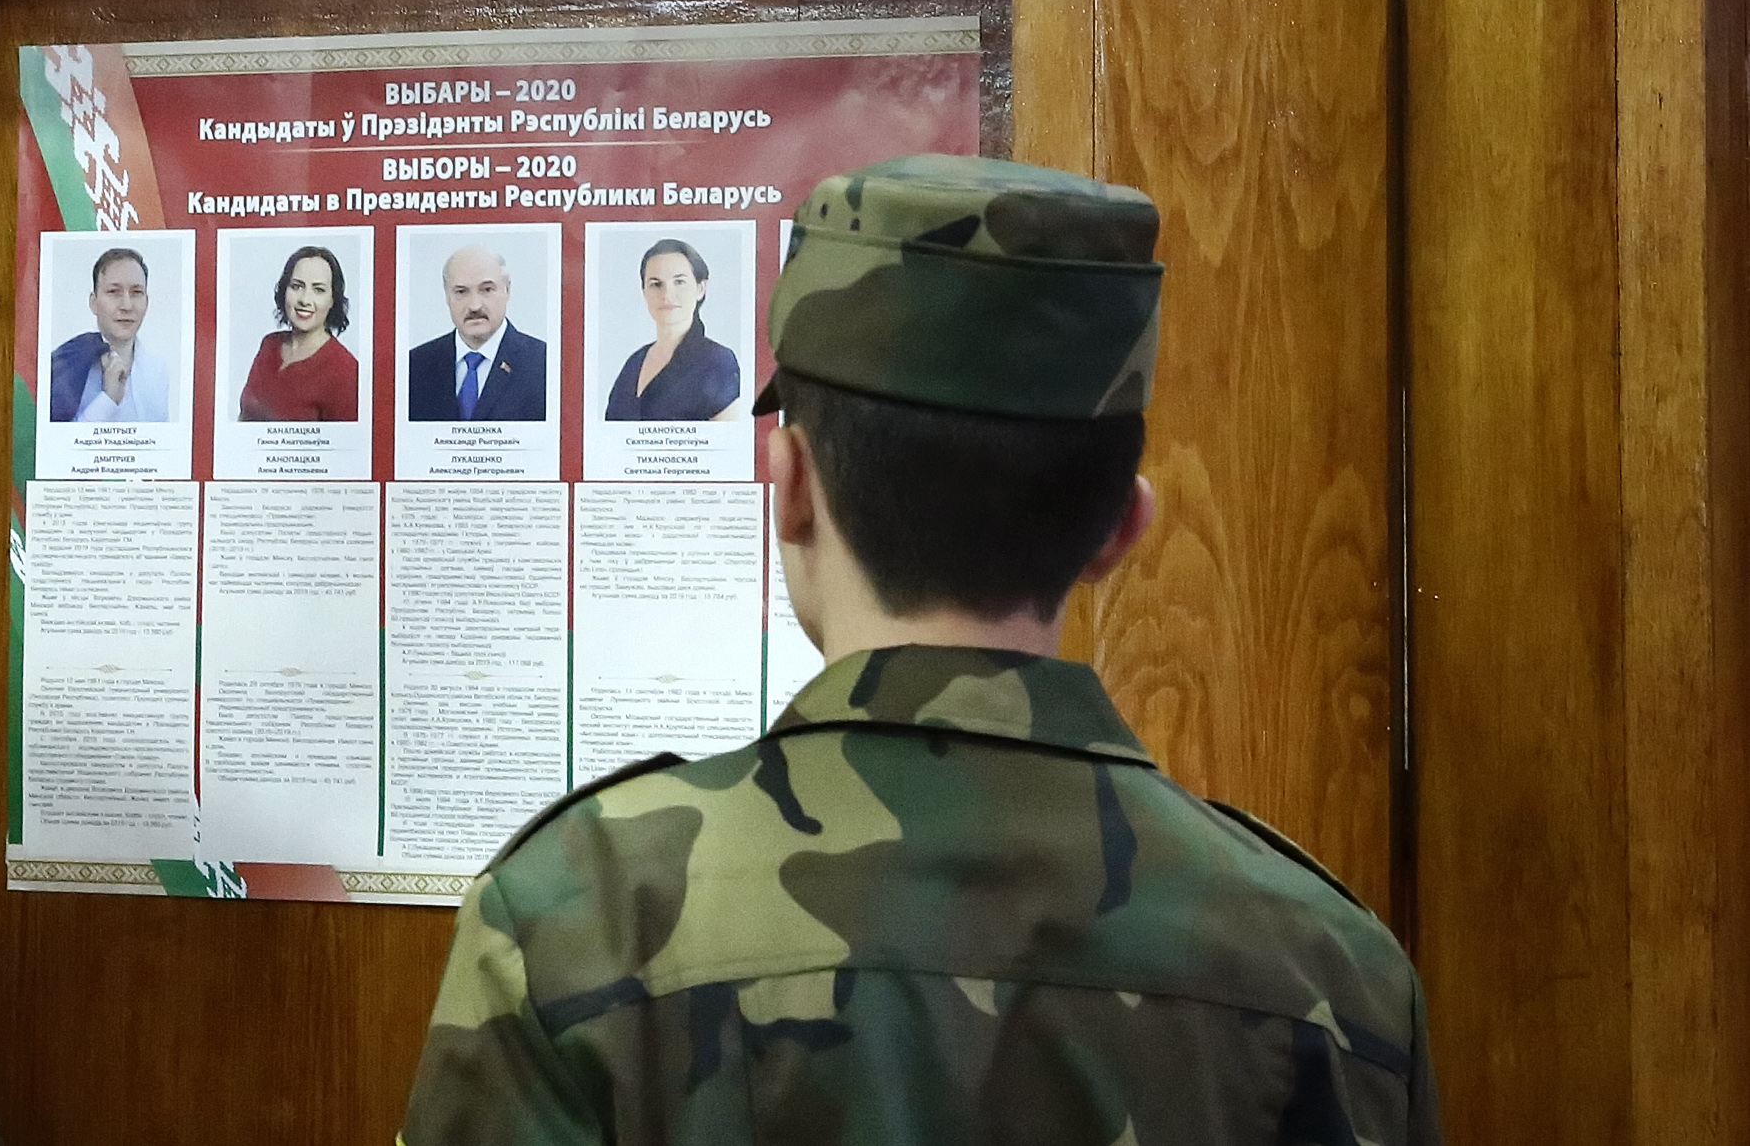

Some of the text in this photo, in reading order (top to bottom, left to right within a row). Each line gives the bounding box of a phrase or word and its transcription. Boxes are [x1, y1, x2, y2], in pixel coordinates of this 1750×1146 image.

[385, 80, 491, 105] ВЫБАРЫ
[515, 78, 577, 102] 2020
[199, 107, 772, 144] Кандыдаты ў Прэзідэнты Рэспублікі Беларусь
[382, 156, 491, 181] ВЫБОРЫ
[516, 155, 577, 178] 2020
[187, 182, 783, 217] Кандидаты в Президенты Республики Беларусь
